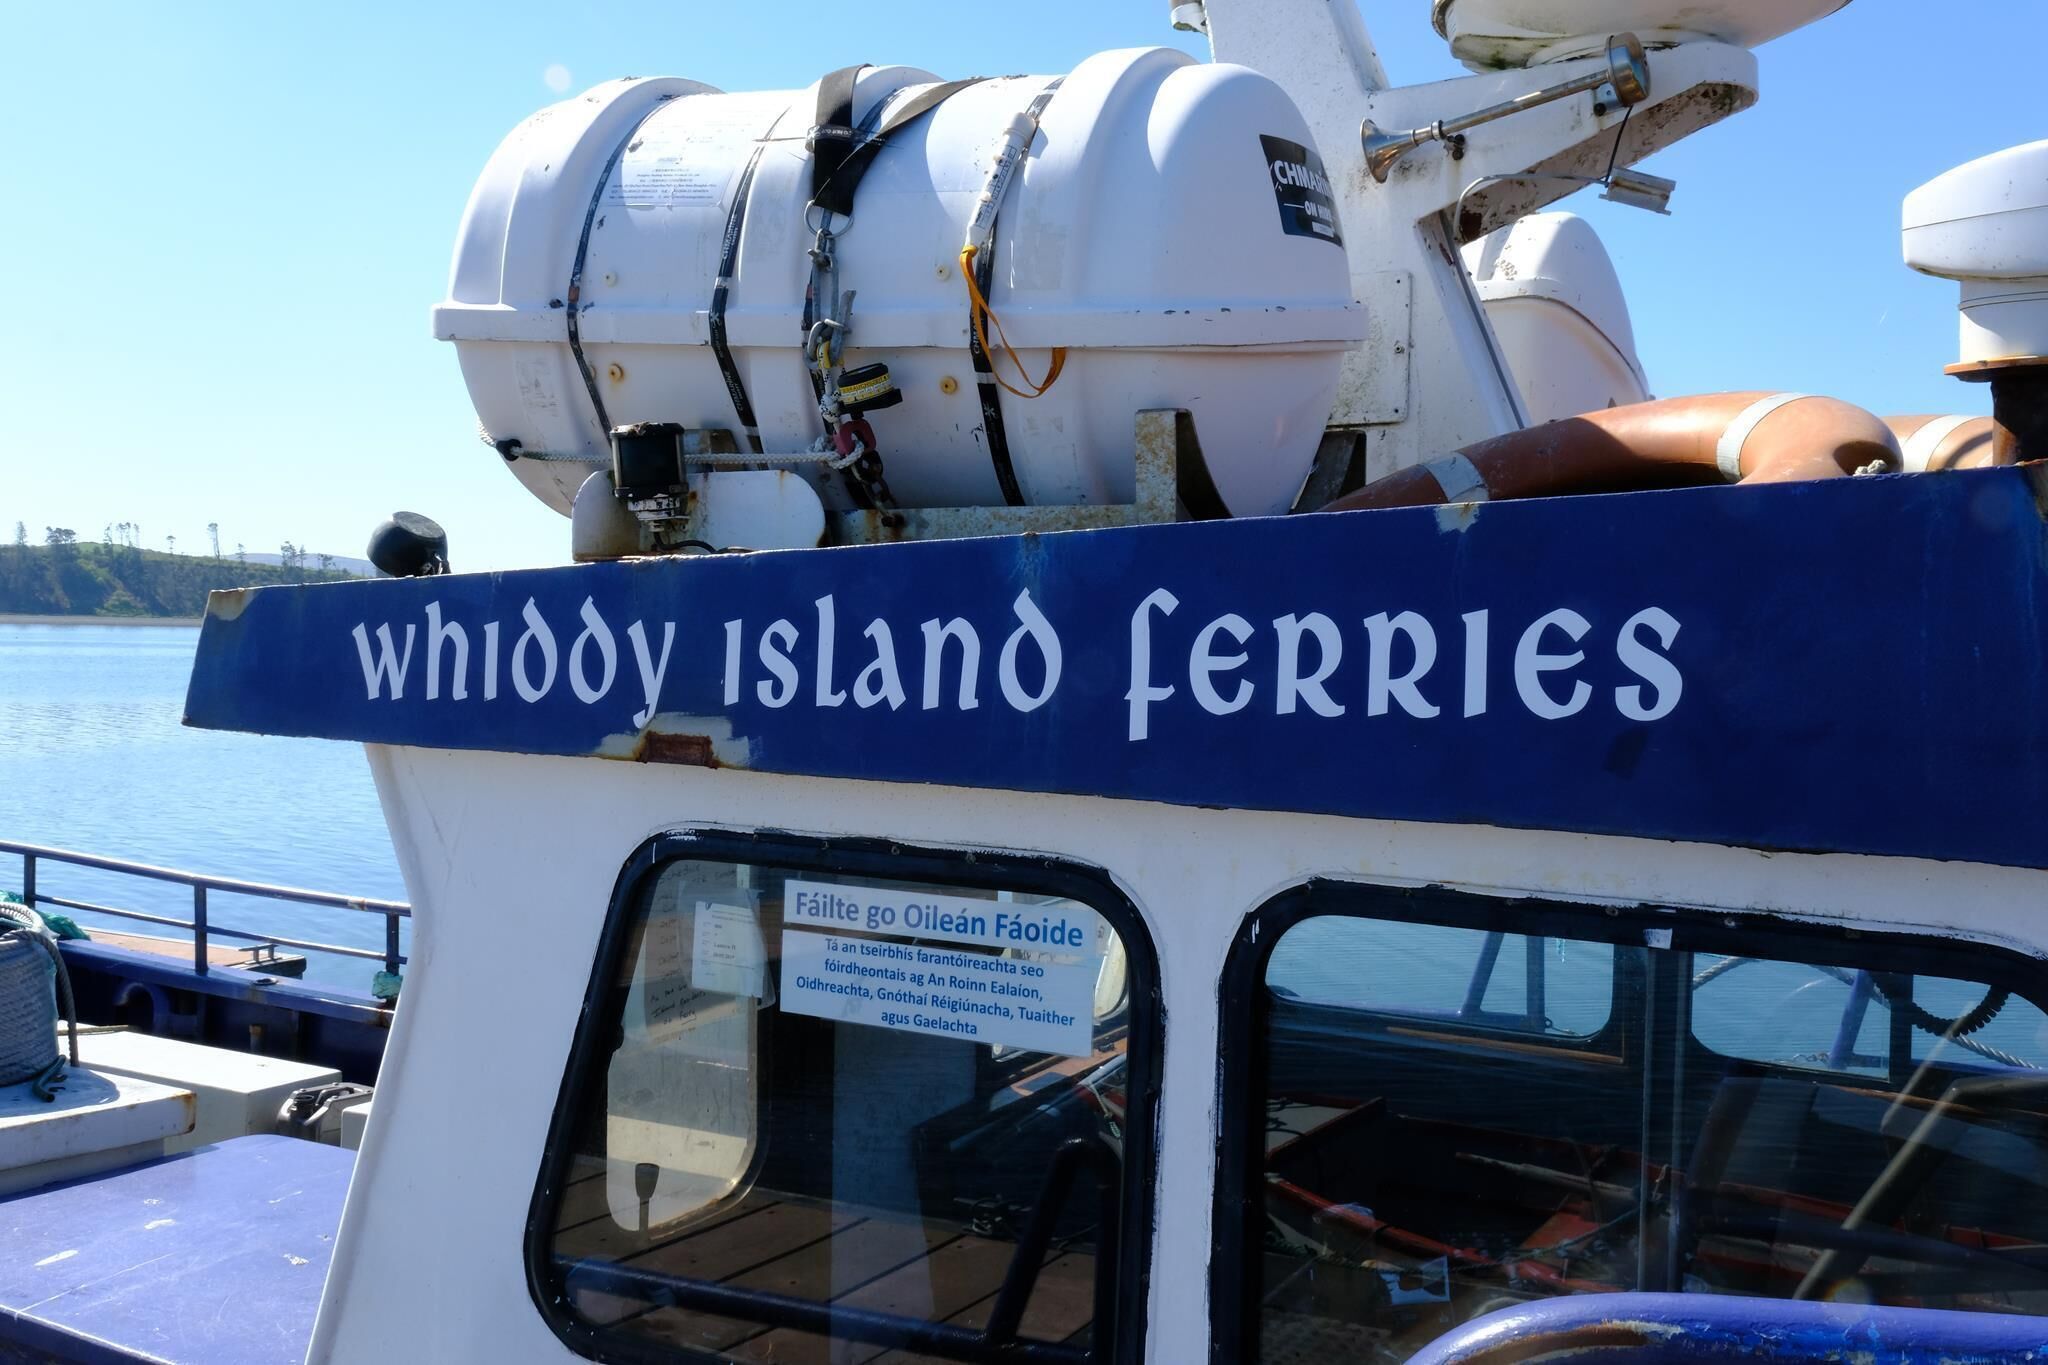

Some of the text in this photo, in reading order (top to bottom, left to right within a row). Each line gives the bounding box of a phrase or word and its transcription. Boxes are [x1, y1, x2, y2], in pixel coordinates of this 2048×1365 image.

[796, 892, 860, 922] Fáilte
[866, 904, 896, 930] go
[904, 903, 986, 936] Oileán
[995, 913, 1084, 947] Fáoide
[824, 958, 1043, 1002] fóirdheontais ag An Roinn Ealaíon,
[825, 938, 1044, 978] Tá an tseirbhís farantóireachta seo
[796, 975, 1076, 1027] Oidhreachta, Gnóthaí Réigiúnacha, Tuaither
[881, 1010, 978, 1035] agus Gaelachta
